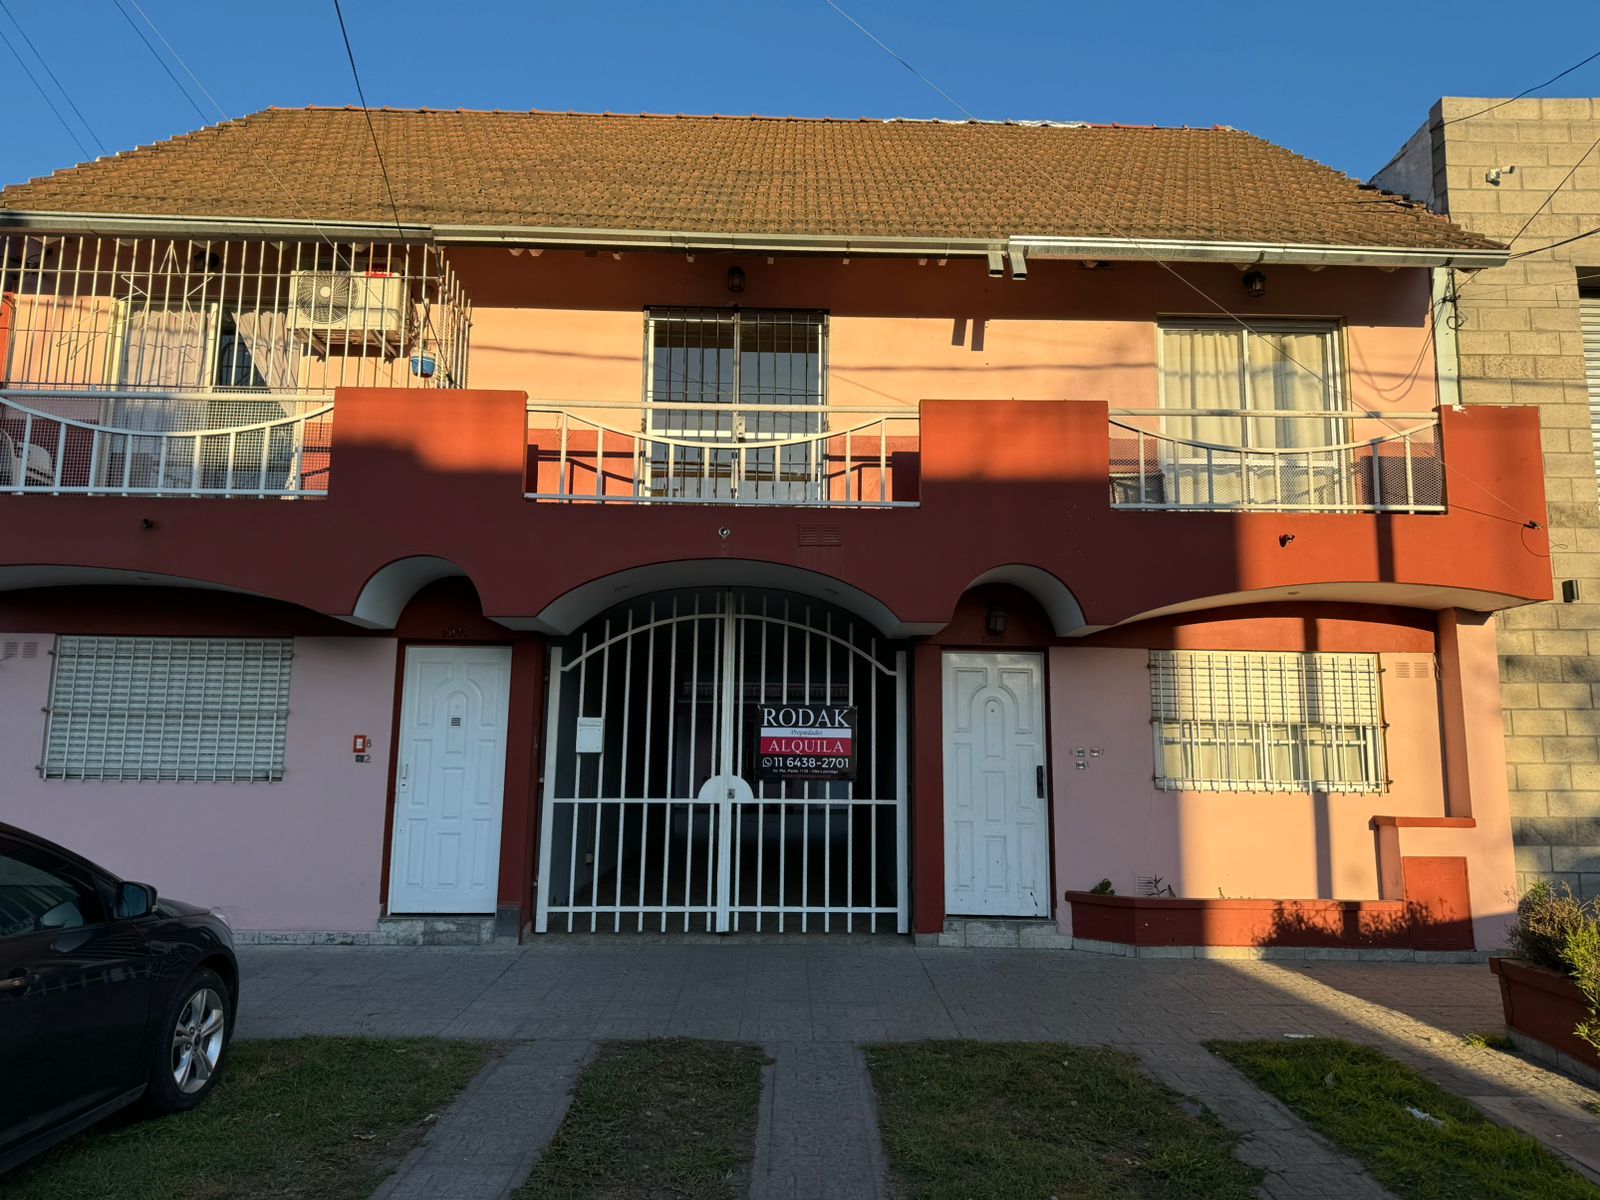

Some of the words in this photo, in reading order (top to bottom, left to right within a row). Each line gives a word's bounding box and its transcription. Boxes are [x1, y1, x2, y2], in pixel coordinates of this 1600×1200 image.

[761, 708, 851, 728] RODAK
[768, 740, 844, 755] ALQUILA
[774, 757, 783, 767] 11
[786, 757, 849, 768] 6438-2701
